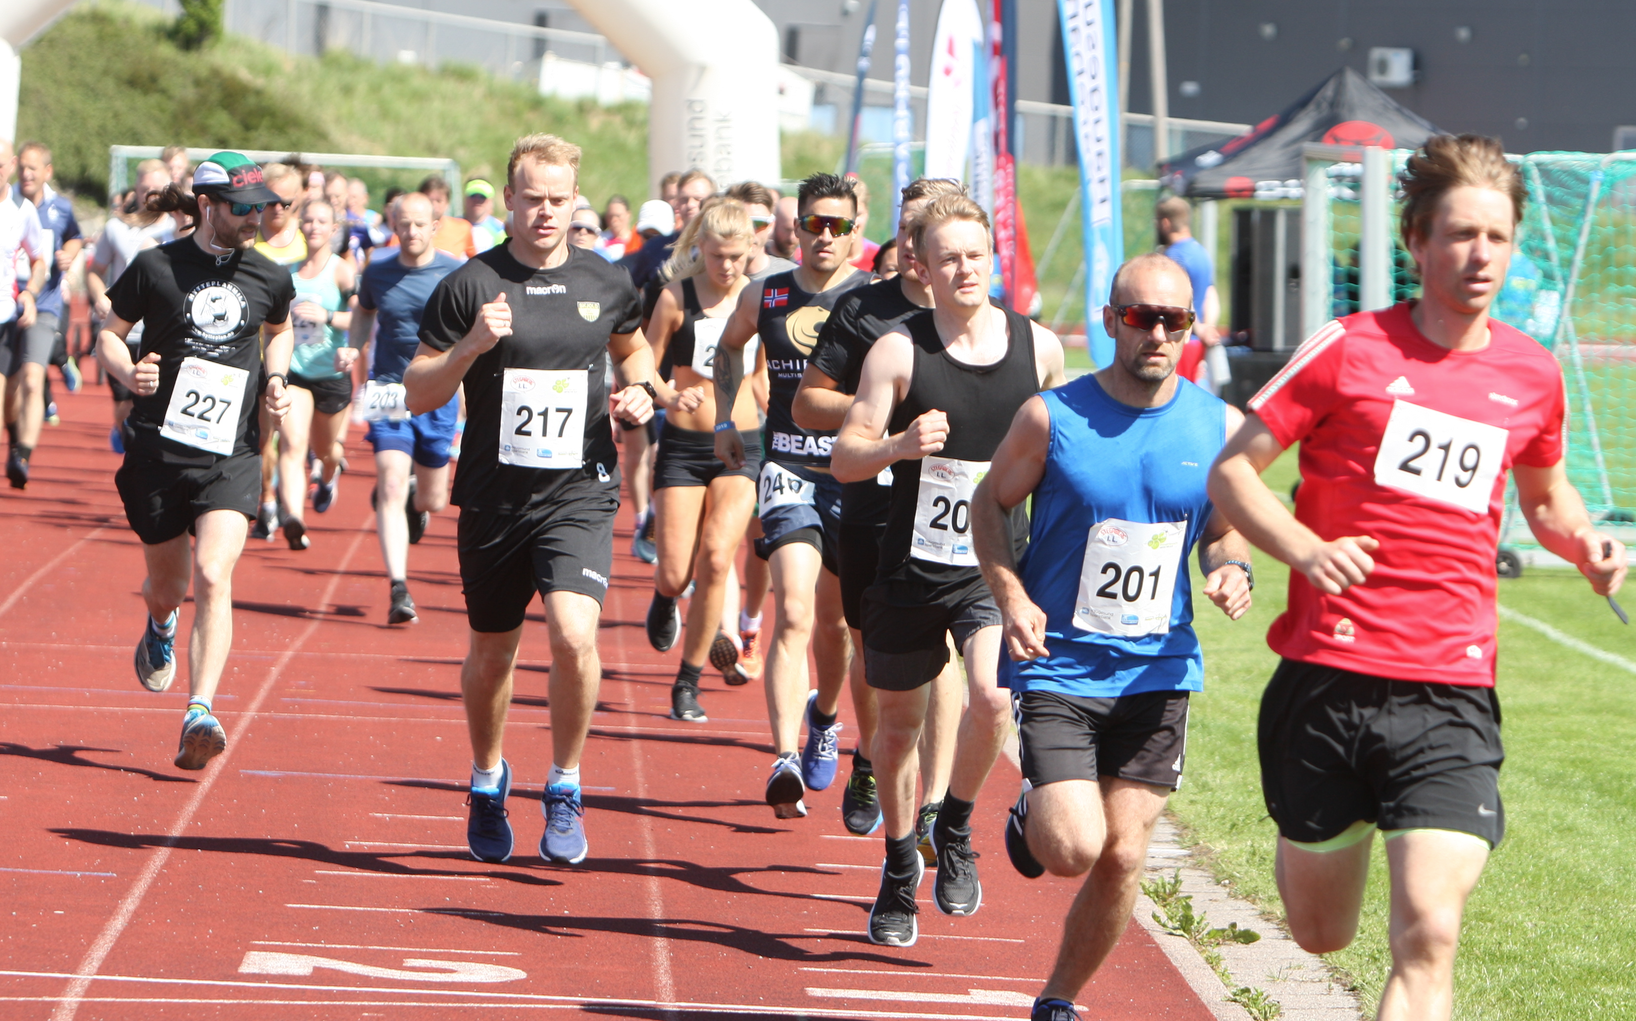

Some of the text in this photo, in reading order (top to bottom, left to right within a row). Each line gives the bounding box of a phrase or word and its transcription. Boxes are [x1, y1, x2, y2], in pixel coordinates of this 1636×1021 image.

[526, 284, 567, 295] macron
[180, 389, 231, 424] 227
[370, 391, 398, 409] 203
[514, 405, 573, 438] 217
[777, 432, 840, 457] BEAS
[1398, 427, 1481, 489] 219
[1096, 561, 1162, 603] 201
